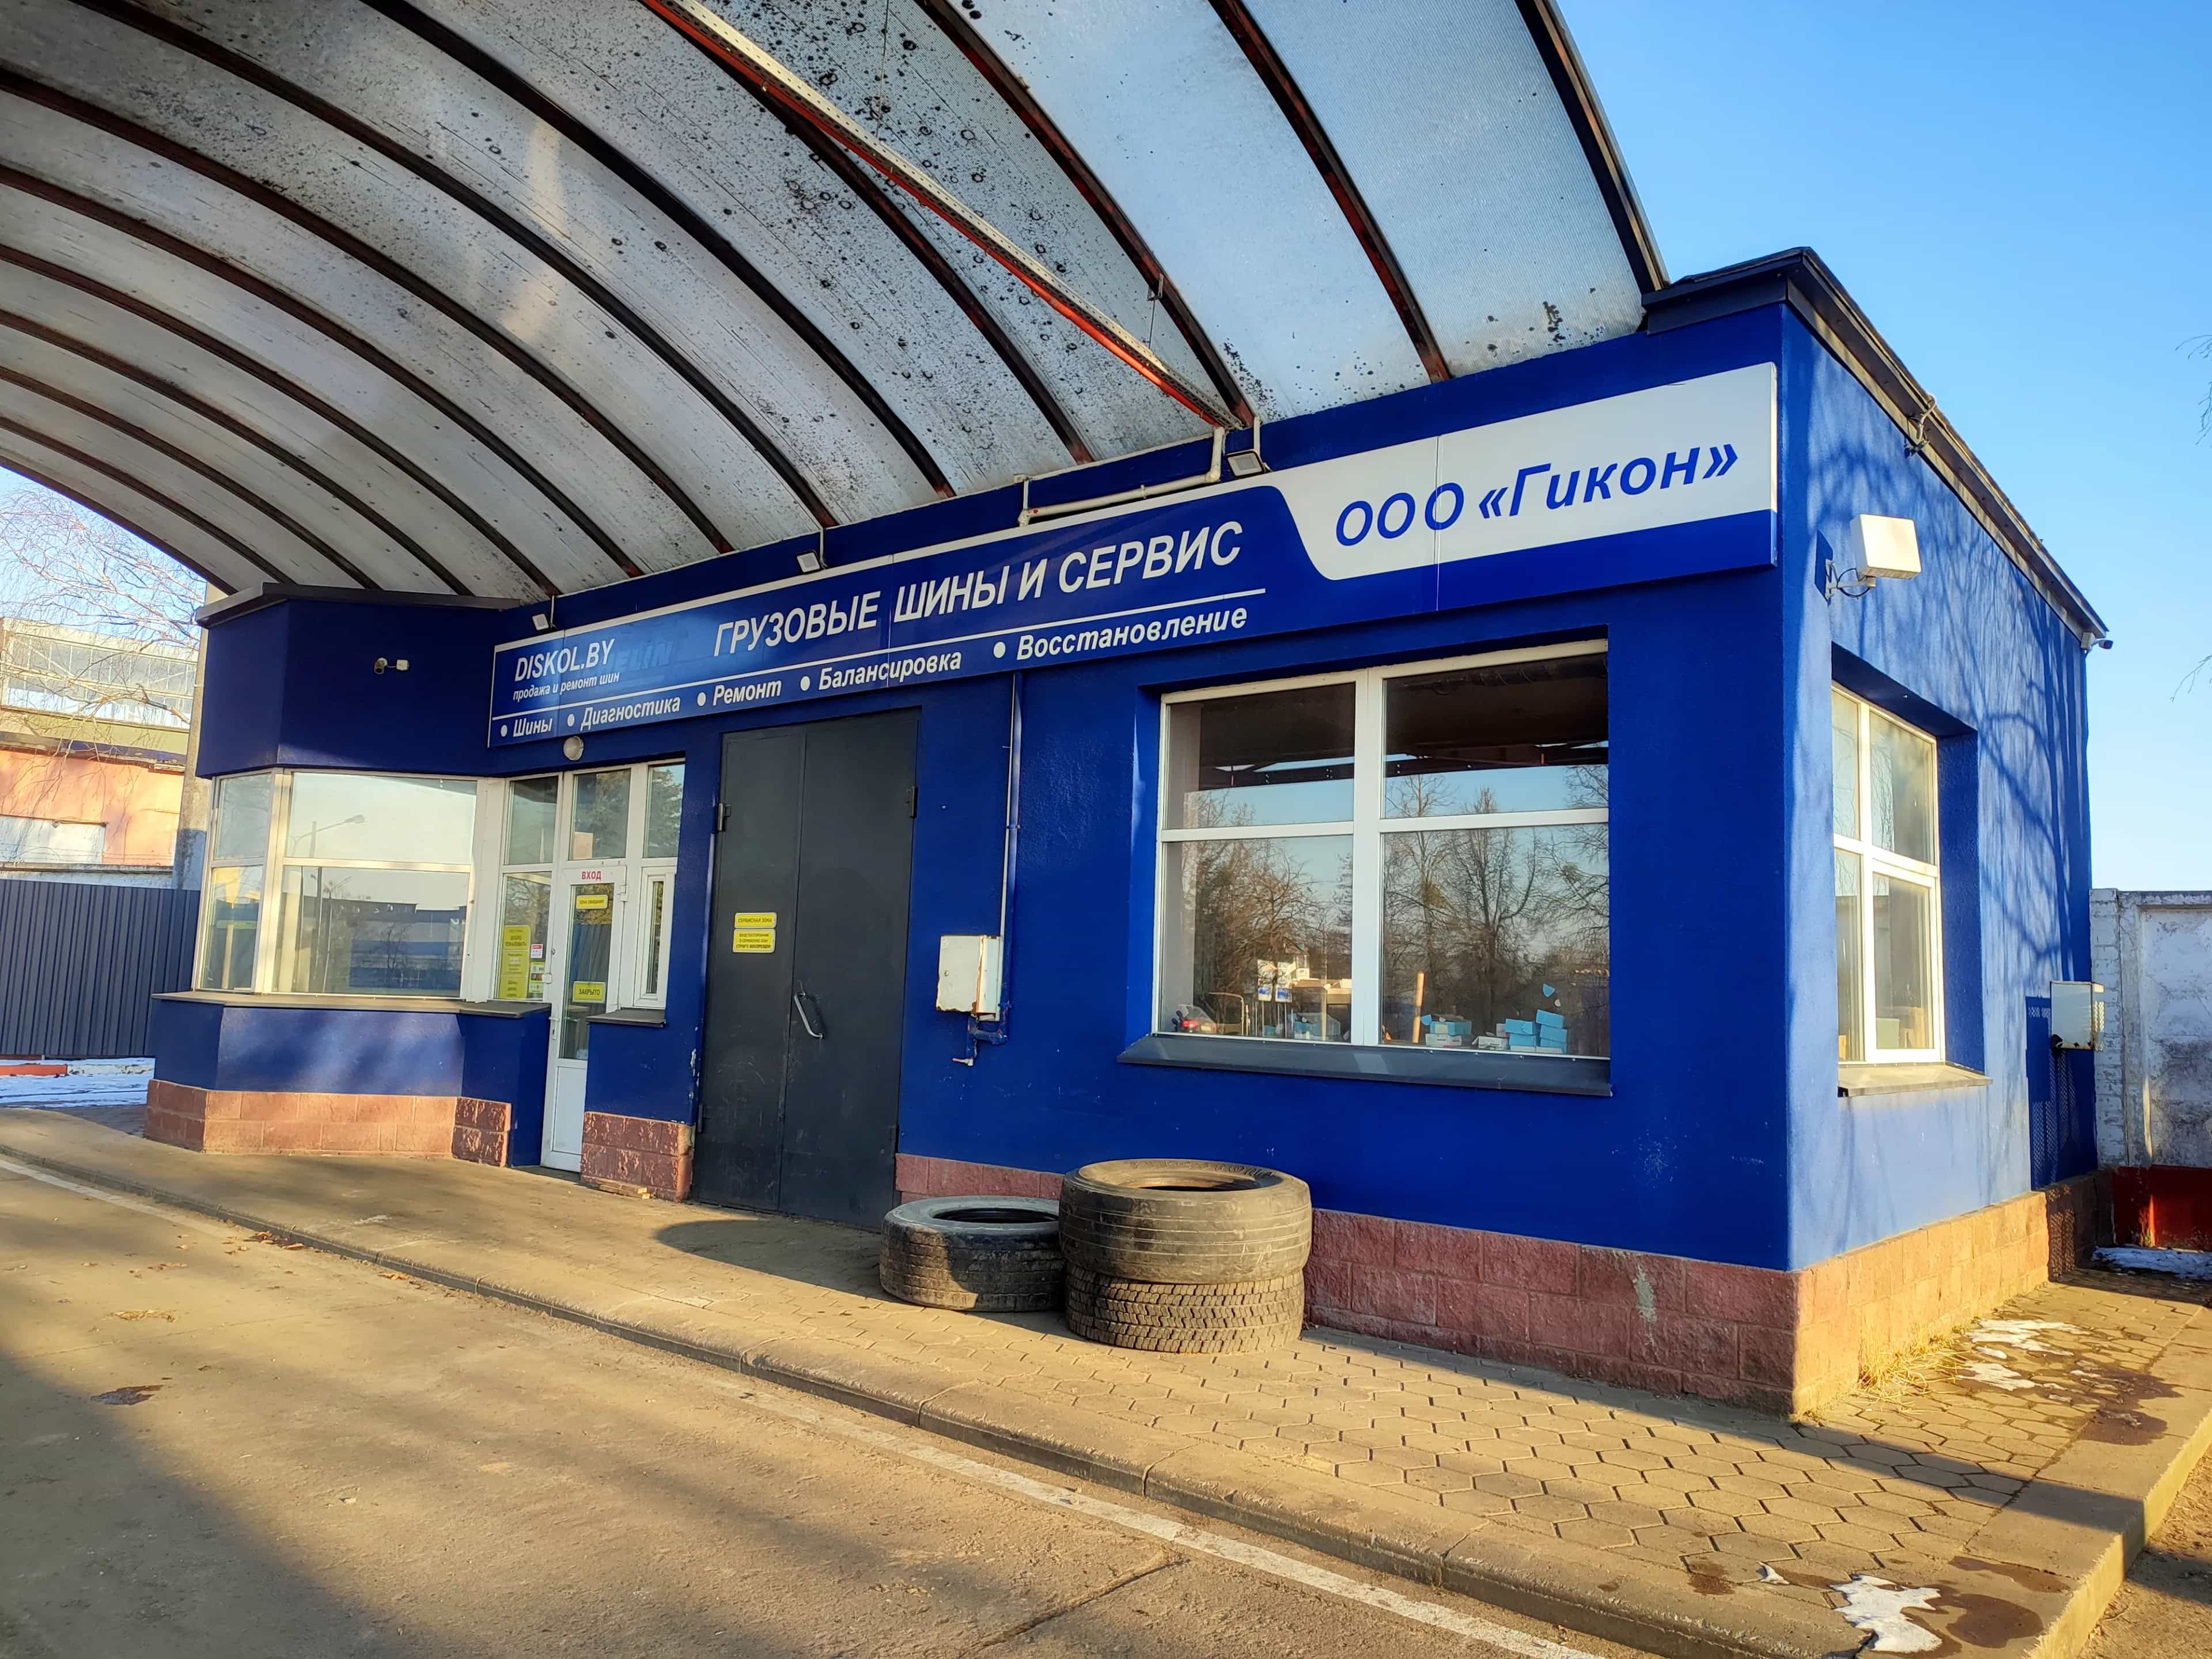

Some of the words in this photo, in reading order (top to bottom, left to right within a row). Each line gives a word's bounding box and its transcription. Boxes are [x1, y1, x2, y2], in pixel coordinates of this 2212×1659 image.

[1336, 483, 1464, 546] ООО
[1479, 444, 1738, 519] «Гикон»
[714, 591, 881, 656] ГРУЗОВЫЕ
[893, 566, 1010, 623] ШИНЫ
[1017, 559, 1046, 601] И
[1059, 521, 1243, 593] СЕРВИС
[513, 718, 552, 737] Шины
[580, 697, 681, 731] Диагностика
[713, 680, 782, 706] Ремонт
[819, 652, 961, 690] Балансировка
[1017, 608, 1247, 660] Восстановление
[513, 685, 551, 701] продажа
[552, 684, 559, 693] и
[560, 676, 597, 695] ремонт
[599, 672, 620, 685] шин
[514, 638, 615, 681] DISKOL.BY
[581, 870, 601, 880] ВХОД
